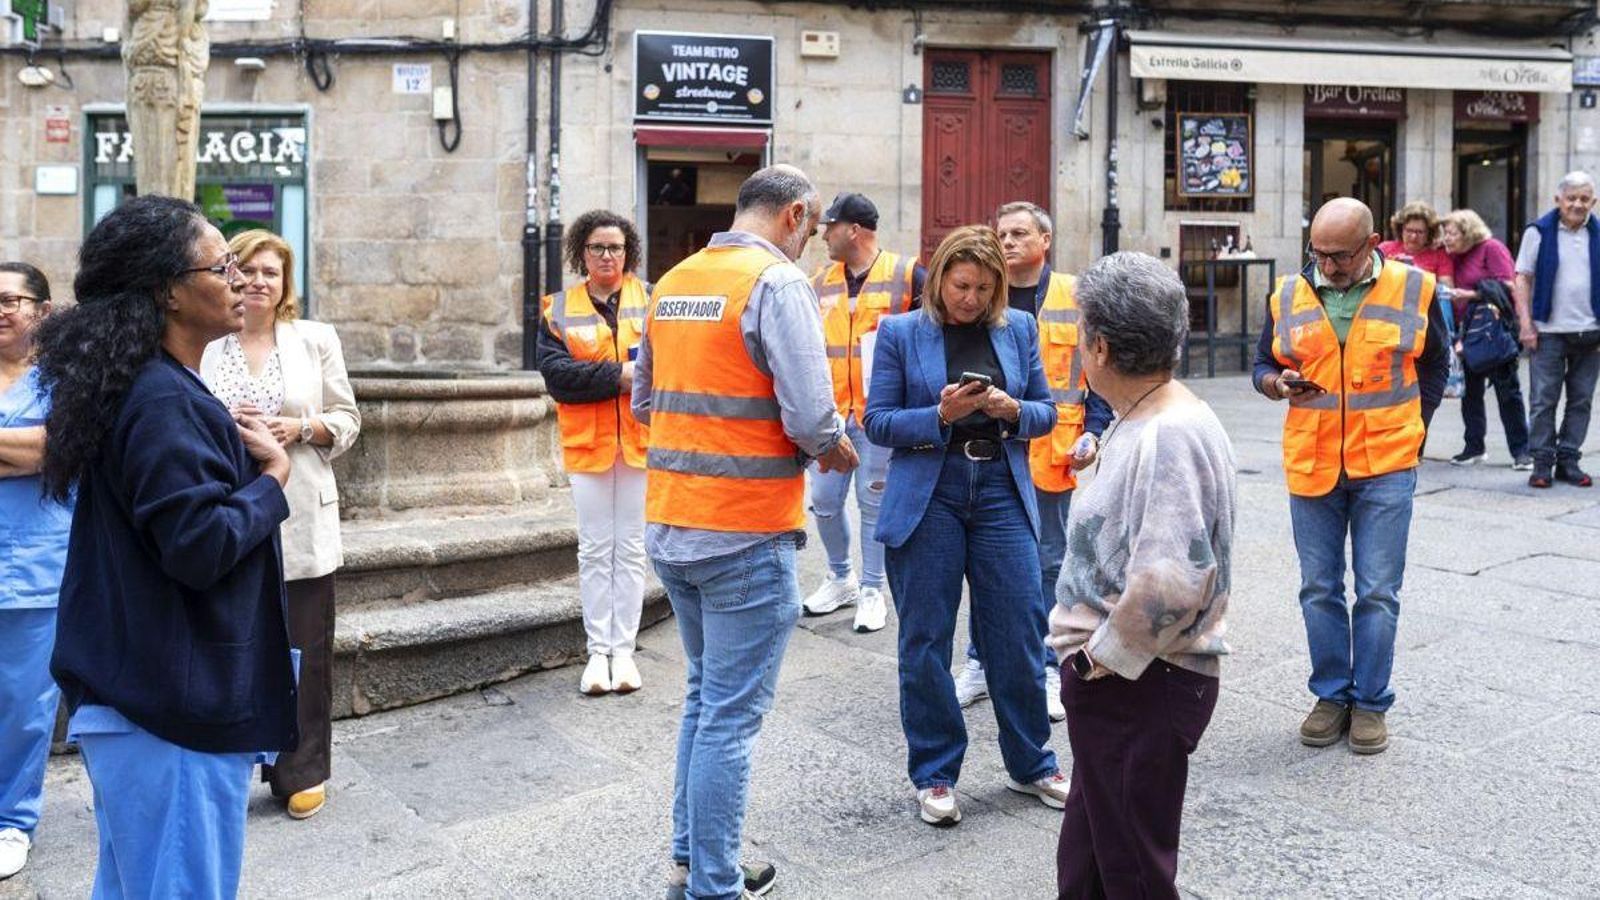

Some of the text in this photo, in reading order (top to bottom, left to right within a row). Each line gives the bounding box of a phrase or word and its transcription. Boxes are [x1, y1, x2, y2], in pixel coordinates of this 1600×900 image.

[672, 45, 739, 59] TEAM RETRO
[1149, 56, 1228, 70] Estrella Galicia
[661, 62, 749, 86] VINTAGE
[675, 86, 736, 99] streetwear
[94, 131, 304, 163] FAACIA
[656, 300, 722, 317] OBSERVADOR
